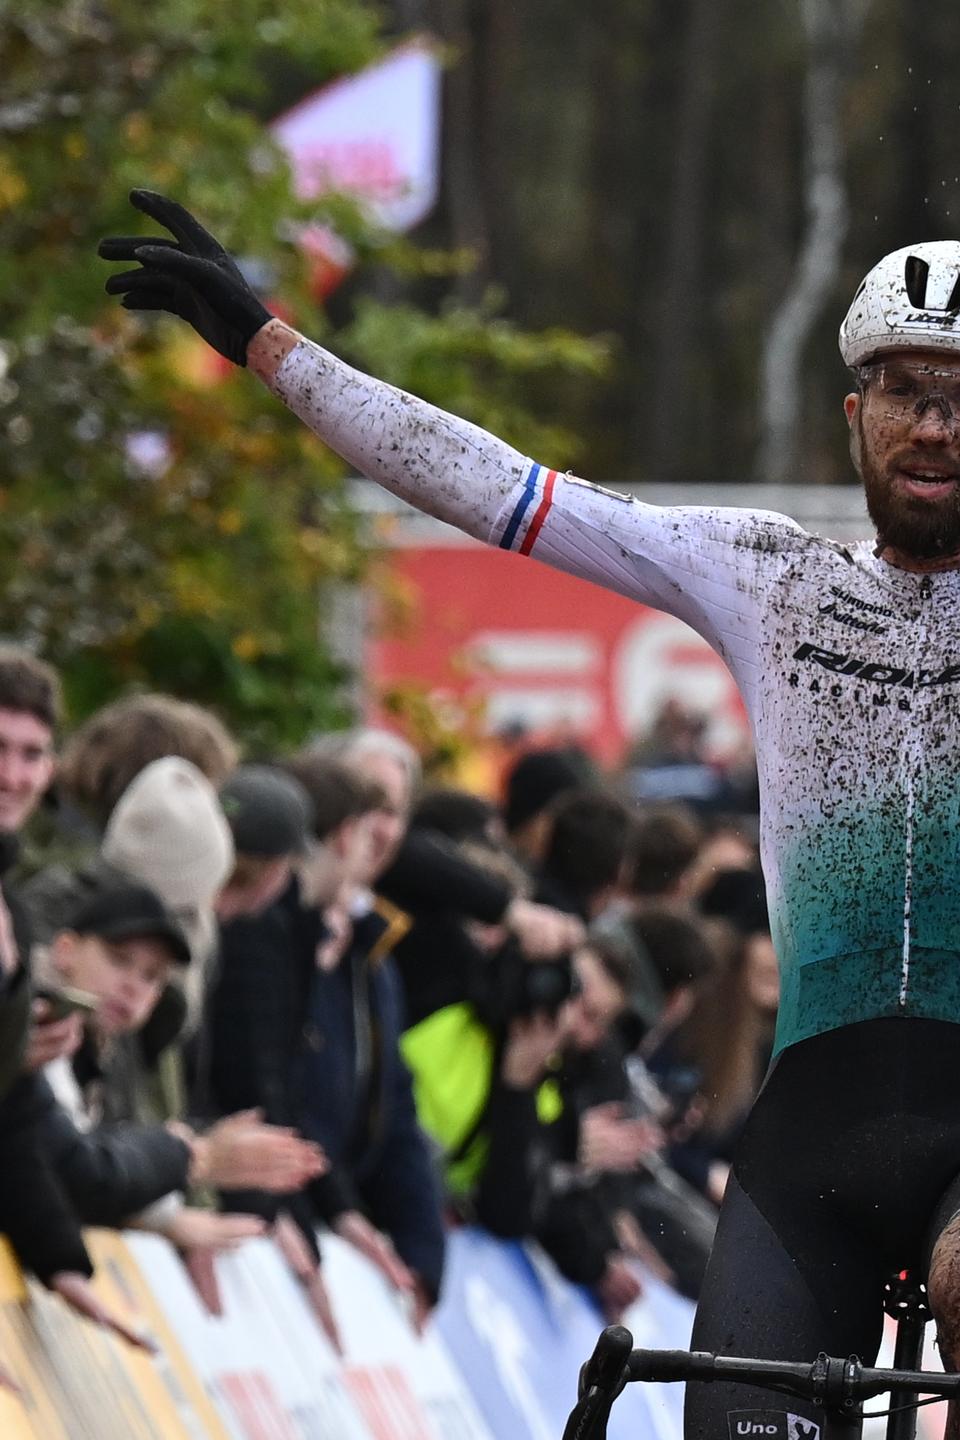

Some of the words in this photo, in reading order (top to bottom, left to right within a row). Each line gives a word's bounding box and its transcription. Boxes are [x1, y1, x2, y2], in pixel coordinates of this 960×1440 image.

[829, 586, 892, 618] SHIMANO
[788, 673, 914, 713] RACING
[737, 1421, 778, 1435] Uno
